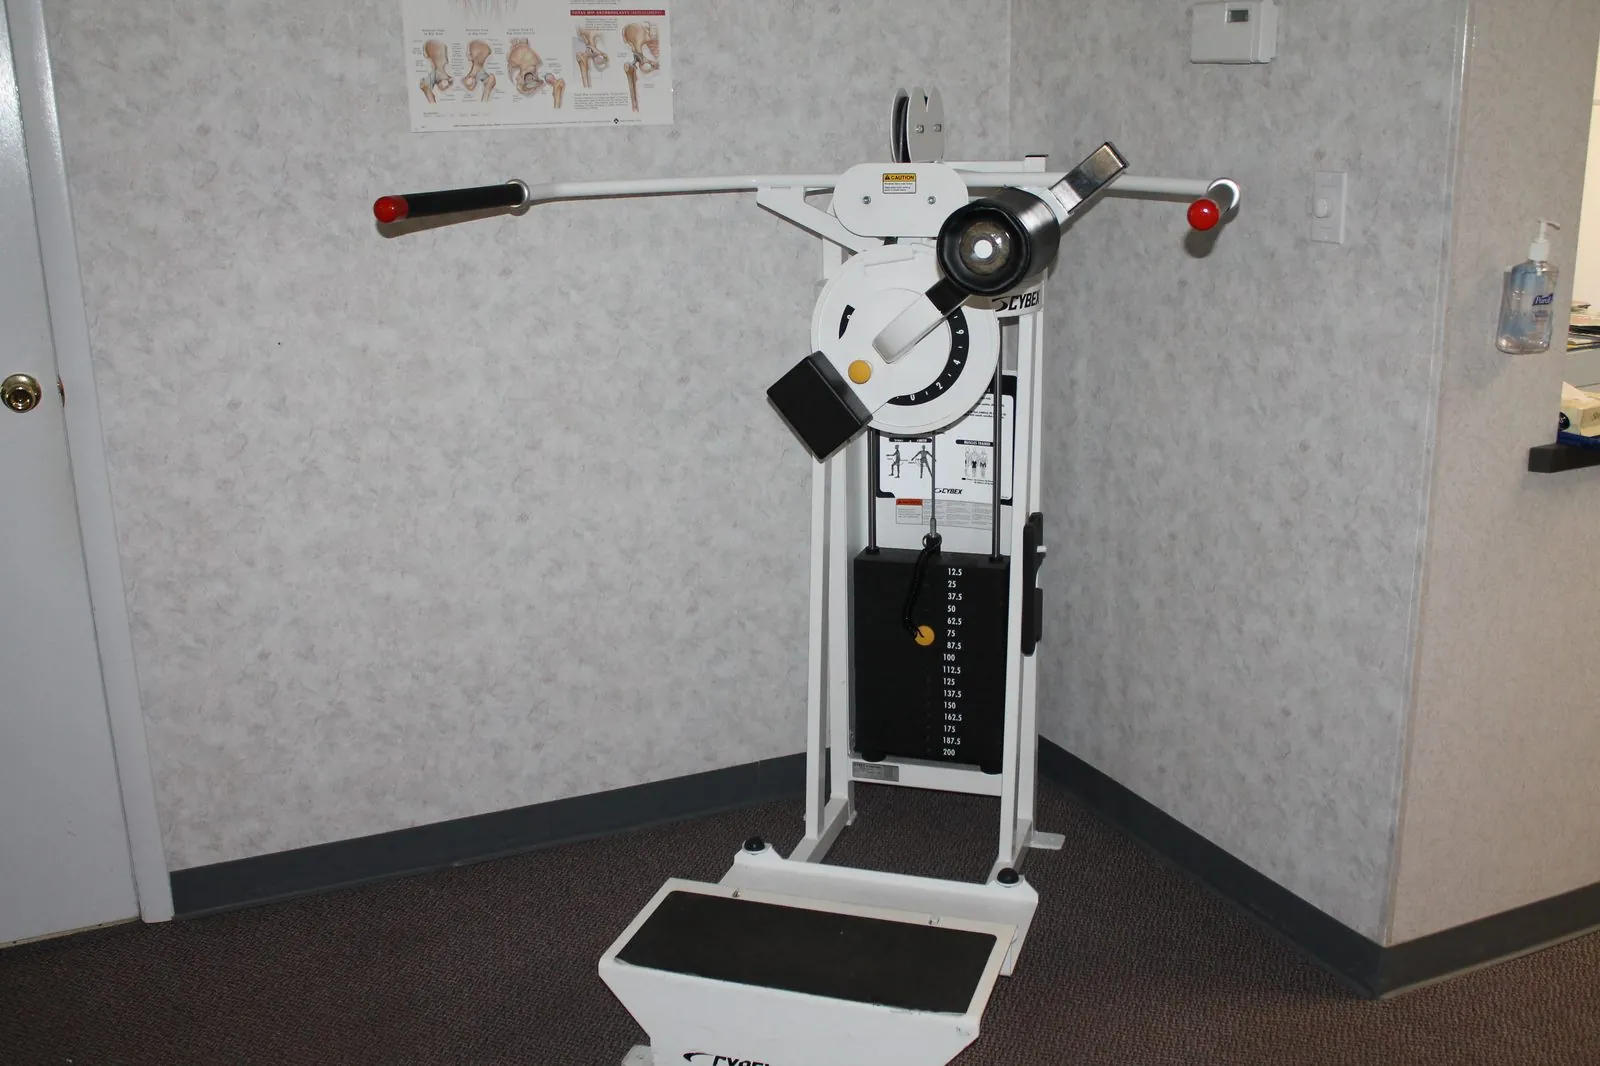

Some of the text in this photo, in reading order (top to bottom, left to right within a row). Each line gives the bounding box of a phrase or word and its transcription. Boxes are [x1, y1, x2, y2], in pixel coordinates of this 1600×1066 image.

[1008, 290, 1040, 310] CYBEX
[948, 568, 962, 576] 12.5
[948, 580, 956, 588] 25
[947, 617, 961, 625] 62.5
[944, 666, 960, 674] 112.5
[945, 713, 962, 721] 162.5
[944, 737, 960, 745] 187.5
